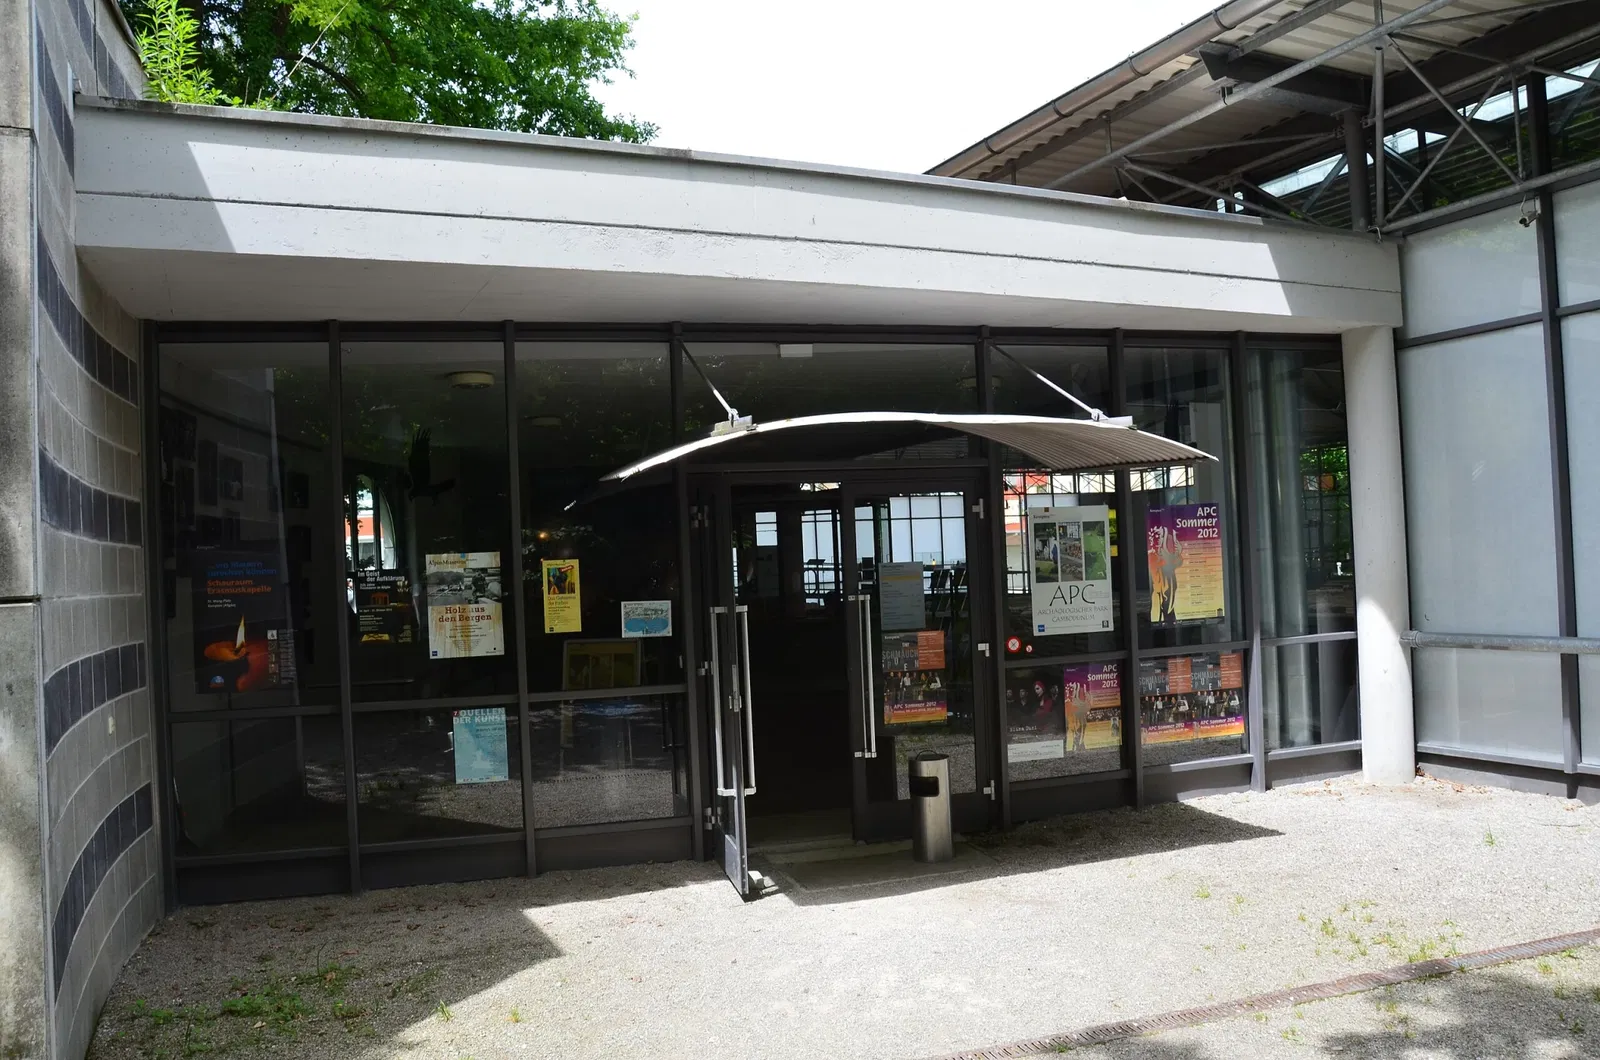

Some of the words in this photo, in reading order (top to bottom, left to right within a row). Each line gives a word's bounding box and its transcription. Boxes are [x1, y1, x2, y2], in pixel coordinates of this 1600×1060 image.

[1197, 507, 1216, 516] APC
[1176, 518, 1217, 528] Sommer
[1198, 528, 1218, 538] 2012
[208, 585, 272, 594] Erasmuskapelle
[1050, 584, 1095, 606] APC
[445, 606, 466, 614] Holz
[458, 614, 492, 622] Bergen
[1087, 673, 1118, 681] Sommer
[460, 708, 505, 716] QUELLEN
[475, 715, 506, 723] KUNST
